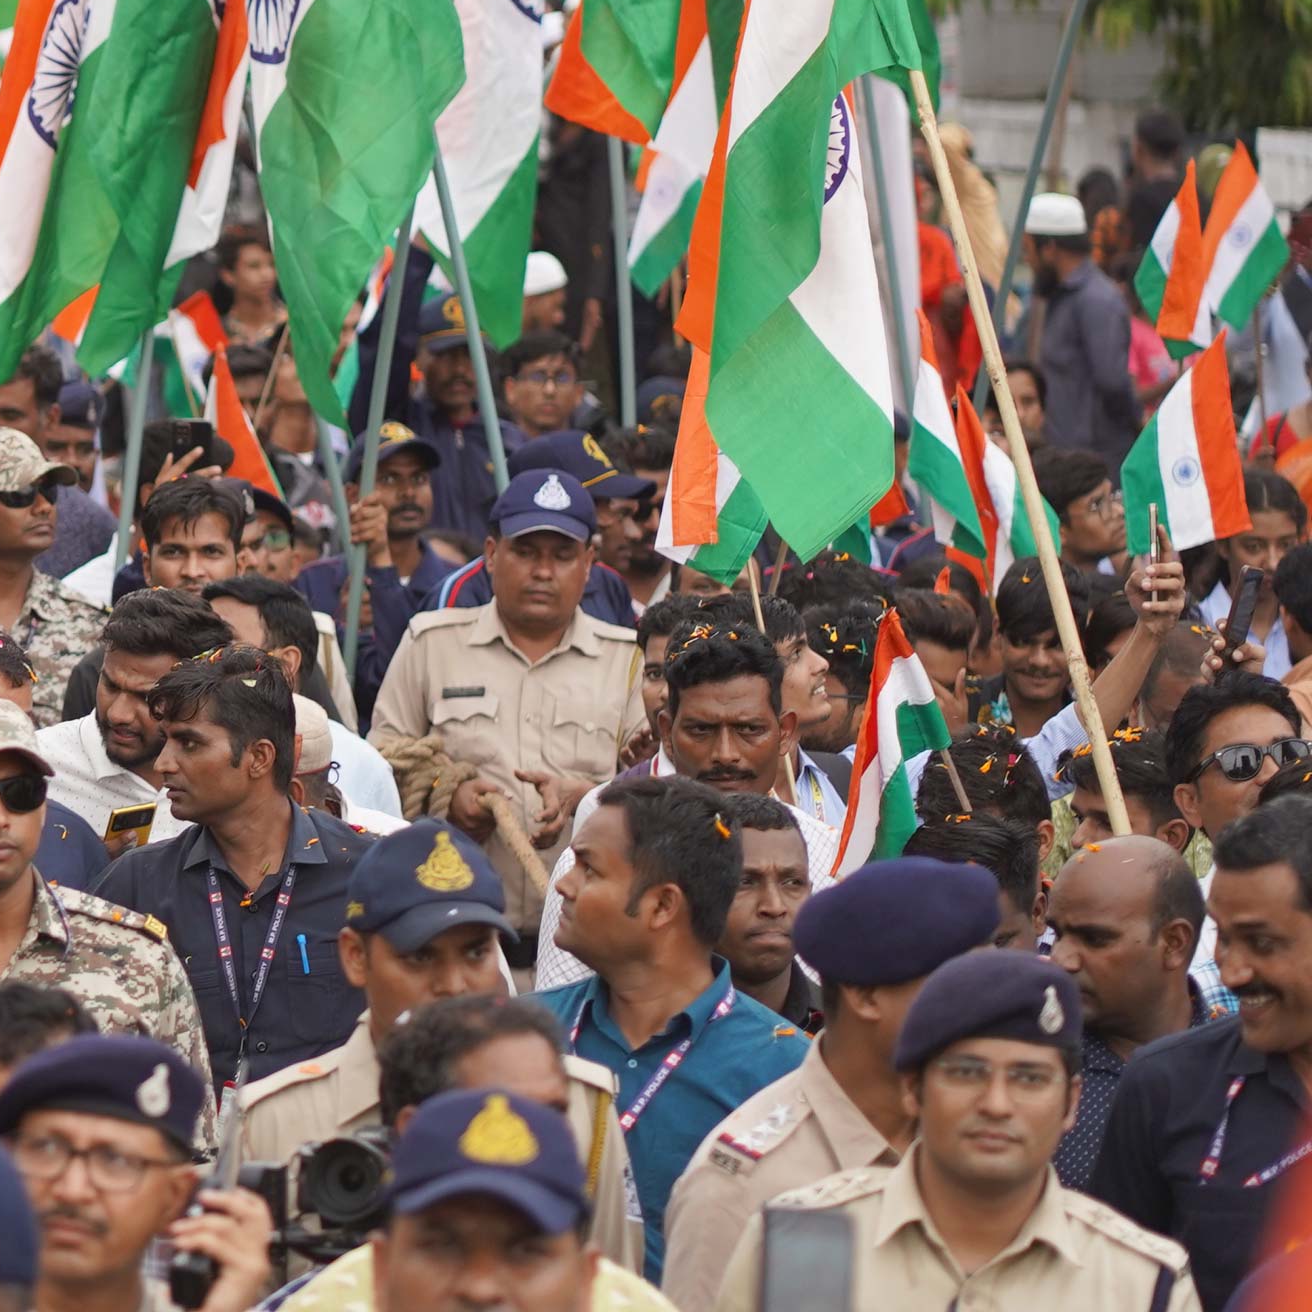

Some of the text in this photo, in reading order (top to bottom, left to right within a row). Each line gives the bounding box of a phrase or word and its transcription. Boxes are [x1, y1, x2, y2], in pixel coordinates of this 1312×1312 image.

[271, 909, 284, 930] POLICE
[254, 961, 269, 990] SECURITY
[645, 1067, 670, 1097] POLICE
